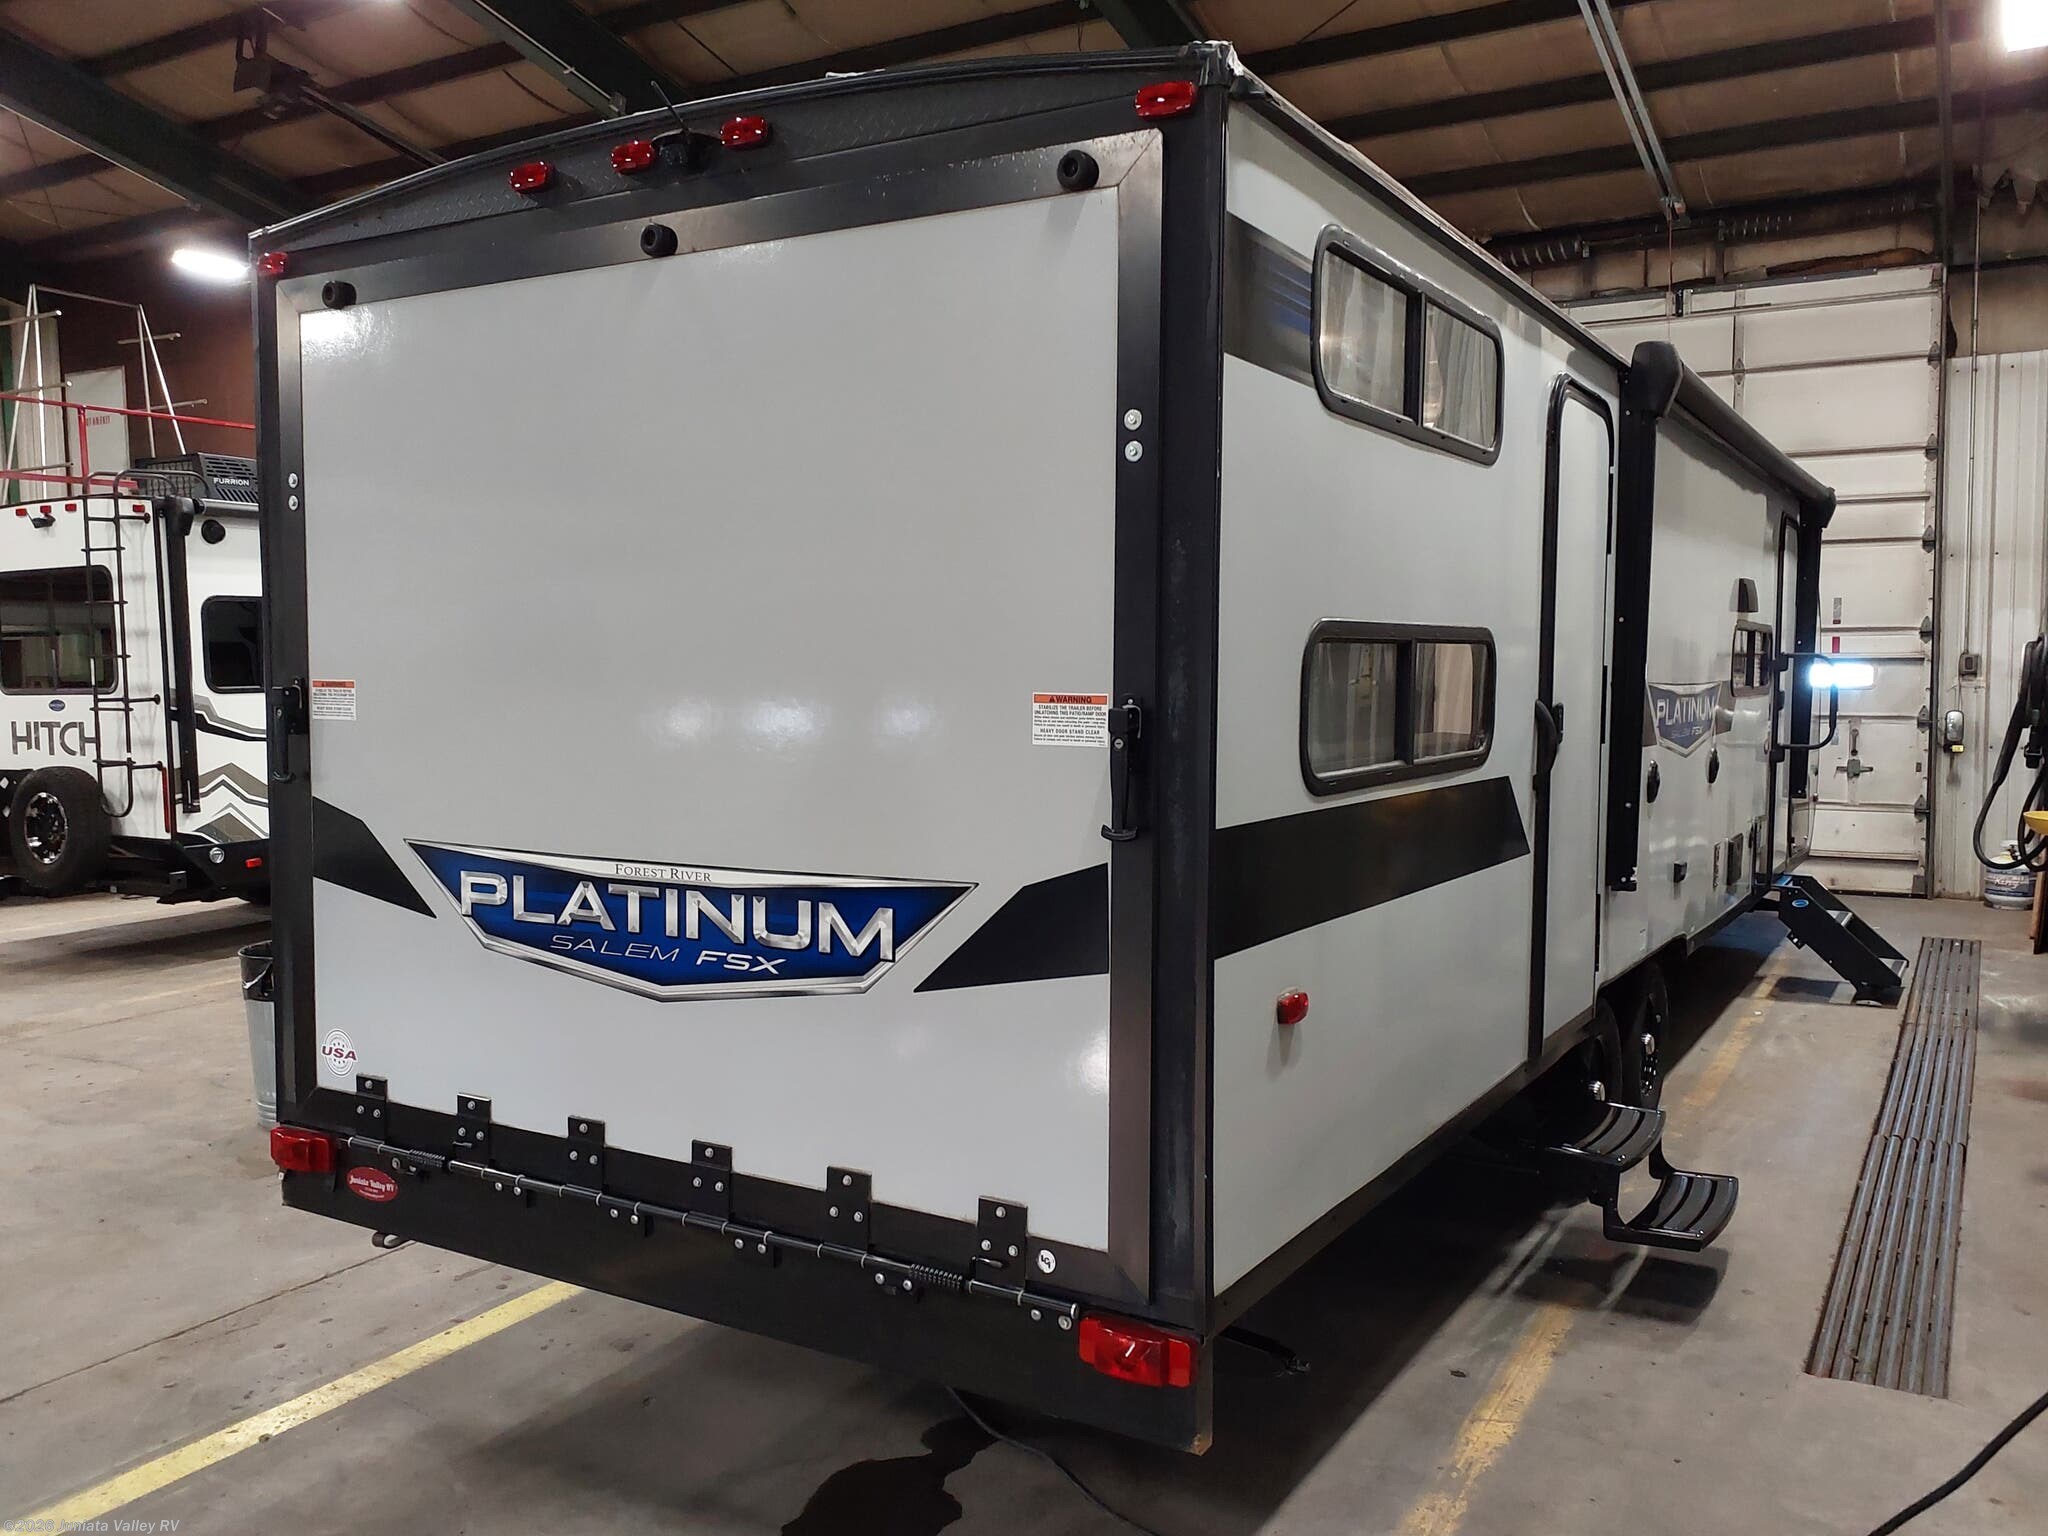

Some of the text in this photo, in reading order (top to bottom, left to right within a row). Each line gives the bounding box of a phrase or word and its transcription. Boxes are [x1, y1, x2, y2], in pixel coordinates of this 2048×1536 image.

[213, 477, 250, 486] FURRION
[1057, 695, 1092, 704] WARNING
[1657, 696, 1715, 725] PLATINUM
[615, 863, 712, 882] FOREST RIVER
[460, 870, 894, 962] PLATINUM
[550, 934, 788, 975] SALEM FSX
[322, 1045, 357, 1061] USA
